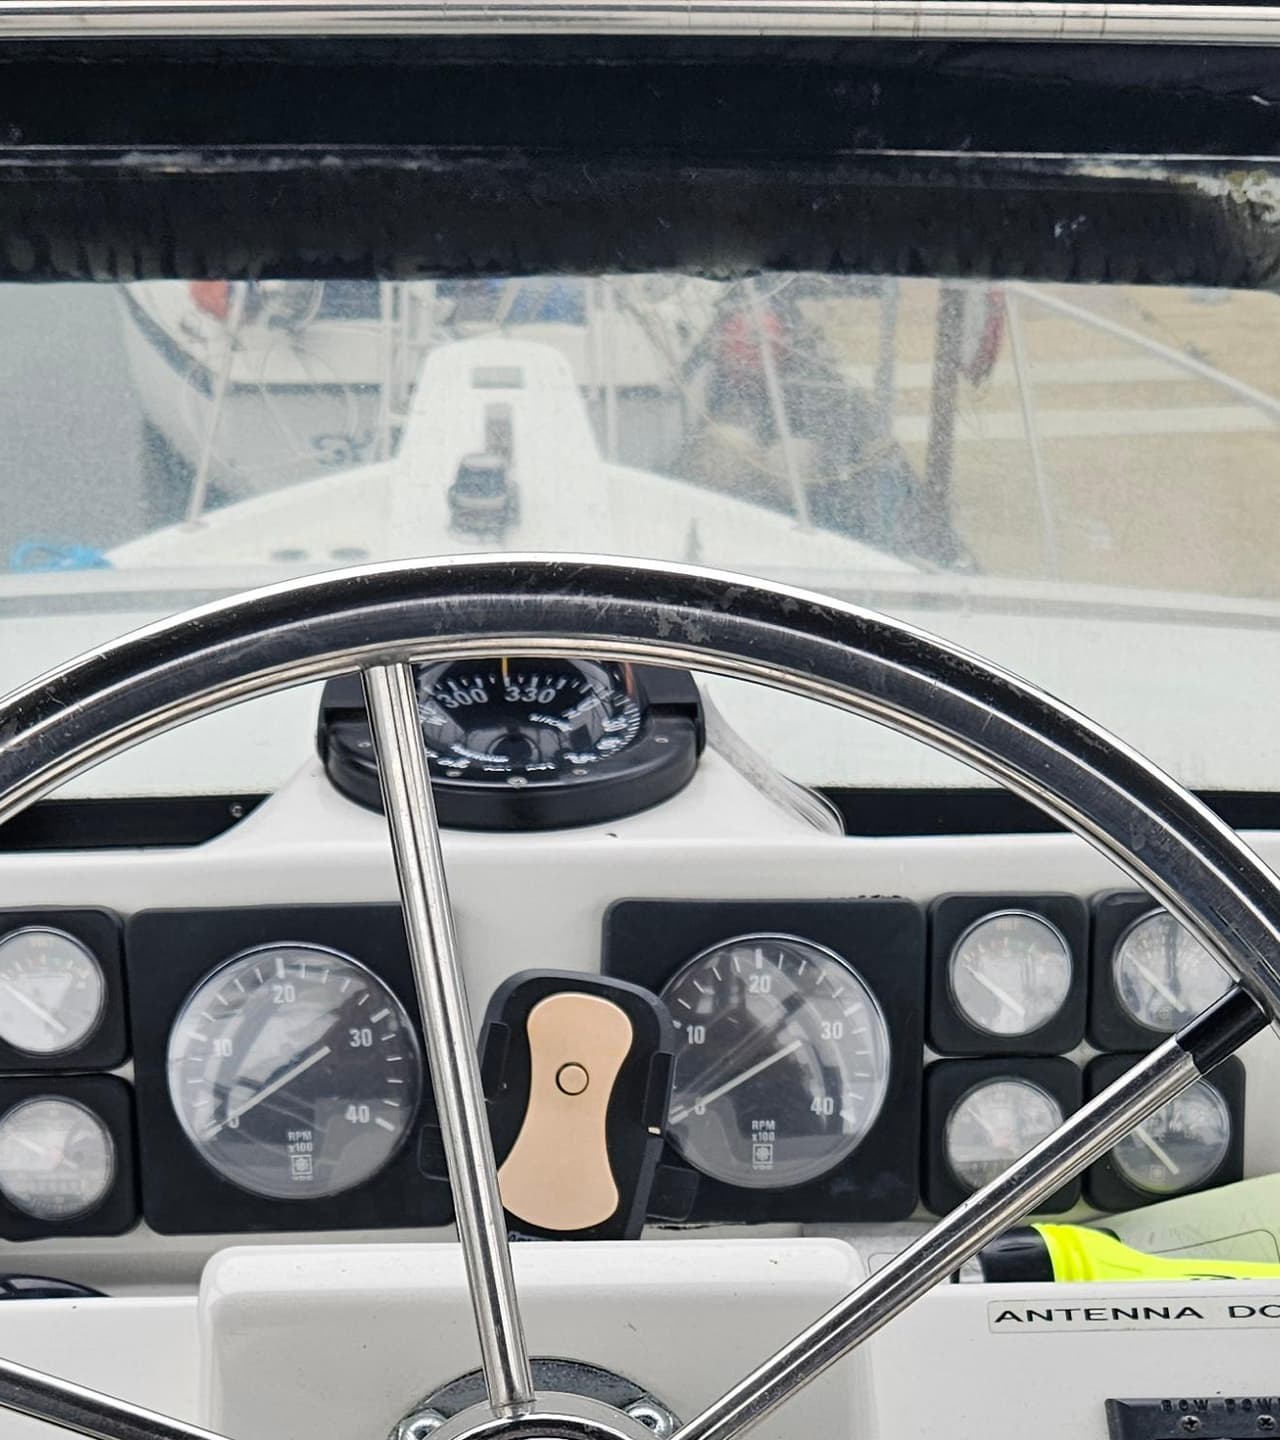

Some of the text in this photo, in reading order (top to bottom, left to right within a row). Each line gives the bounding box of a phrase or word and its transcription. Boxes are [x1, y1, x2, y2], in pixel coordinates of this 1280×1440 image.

[436, 688, 489, 709] 300
[504, 686, 557, 704] 330
[273, 984, 296, 1004] 20
[748, 974, 770, 994] 20
[349, 1028, 373, 1048] 30
[686, 1025, 706, 1045] 10
[821, 1020, 844, 1040] 30
[345, 1104, 370, 1125] 40
[810, 1096, 834, 1116] 40
[751, 1119, 776, 1131] RPM
[287, 1130, 313, 1142] RPM
[993, 1305, 1205, 1323] ANTENNA
